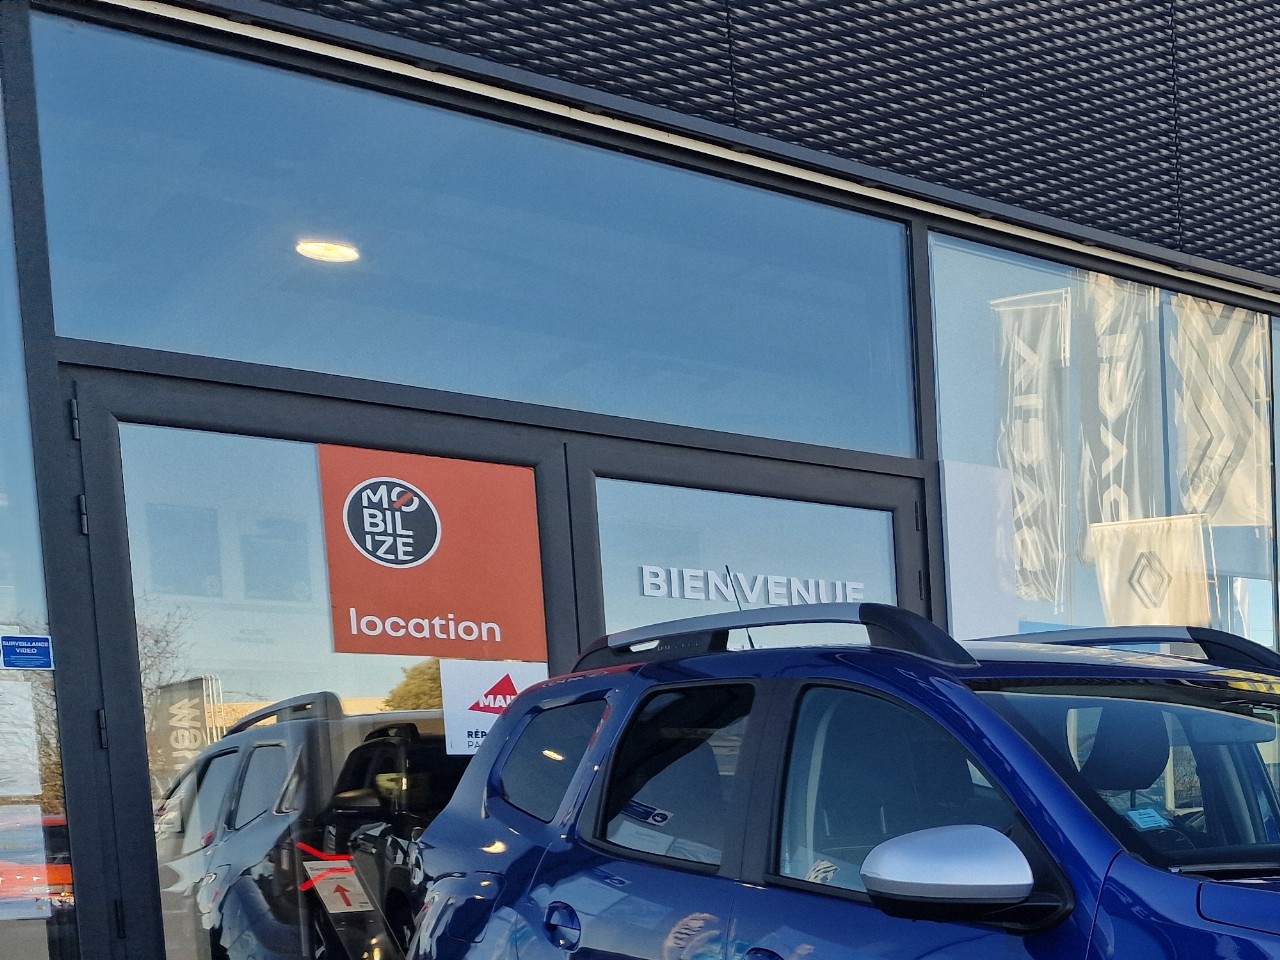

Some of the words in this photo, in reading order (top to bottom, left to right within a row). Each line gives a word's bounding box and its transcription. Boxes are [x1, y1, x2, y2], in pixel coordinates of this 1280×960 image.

[362, 508, 414, 536] BIL
[365, 534, 415, 560] IZE
[640, 564, 865, 605] BIENVENUE
[349, 607, 502, 642] location
[480, 694, 516, 708] MAI
[467, 729, 487, 739] RÉP
[467, 741, 481, 749] PA
